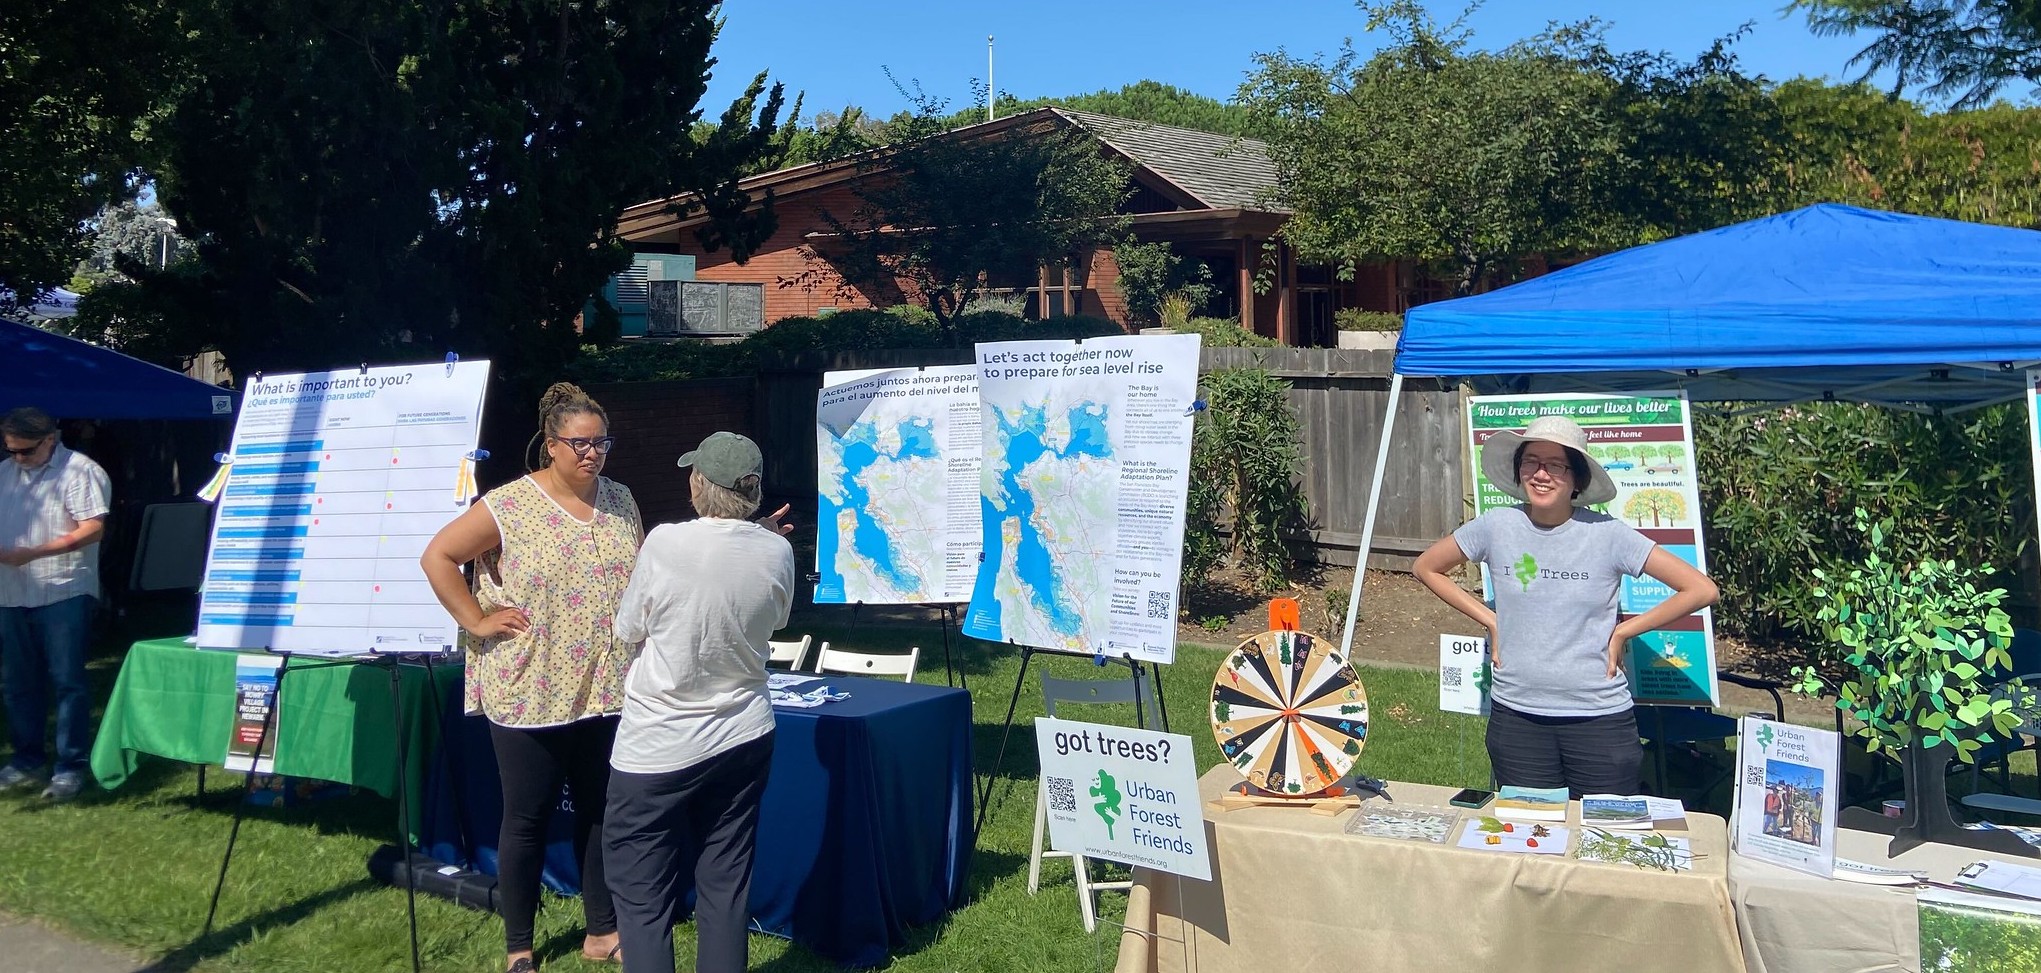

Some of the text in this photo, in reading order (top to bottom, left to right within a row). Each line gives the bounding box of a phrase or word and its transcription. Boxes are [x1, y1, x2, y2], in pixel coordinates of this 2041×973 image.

[984, 349, 1133, 364] Let's act together now
[984, 361, 1164, 380] to prepare for sea level rise
[252, 372, 413, 396] What is important to you?
[822, 373, 978, 398] Actuemos juntos ahora prepar
[247, 389, 376, 408] ¿Qué es importante para usted?
[822, 396, 845, 408] para
[848, 390, 857, 400] el
[860, 389, 906, 399] aumento
[909, 386, 924, 396] del
[926, 385, 950, 395] nivel
[953, 384, 968, 393] del
[1478, 401, 1671, 417] How trees make our lives better
[1588, 431, 1602, 440] feel
[1504, 566, 1589, 580] I Trees
[1632, 586, 1671, 596] SUPPLY
[1453, 640, 1490, 654] got t
[261, 684, 269, 692] TO
[1777, 729, 1805, 741] Urban
[1055, 730, 1171, 764] got trees?
[1777, 739, 1806, 751] Forest
[1776, 749, 1810, 762] Friends
[1126, 780, 1176, 804] Urban
[1129, 804, 1182, 829] Forest
[1133, 828, 1193, 855] Friends
[1085, 846, 1167, 868] www.urbanforestfriends.org
